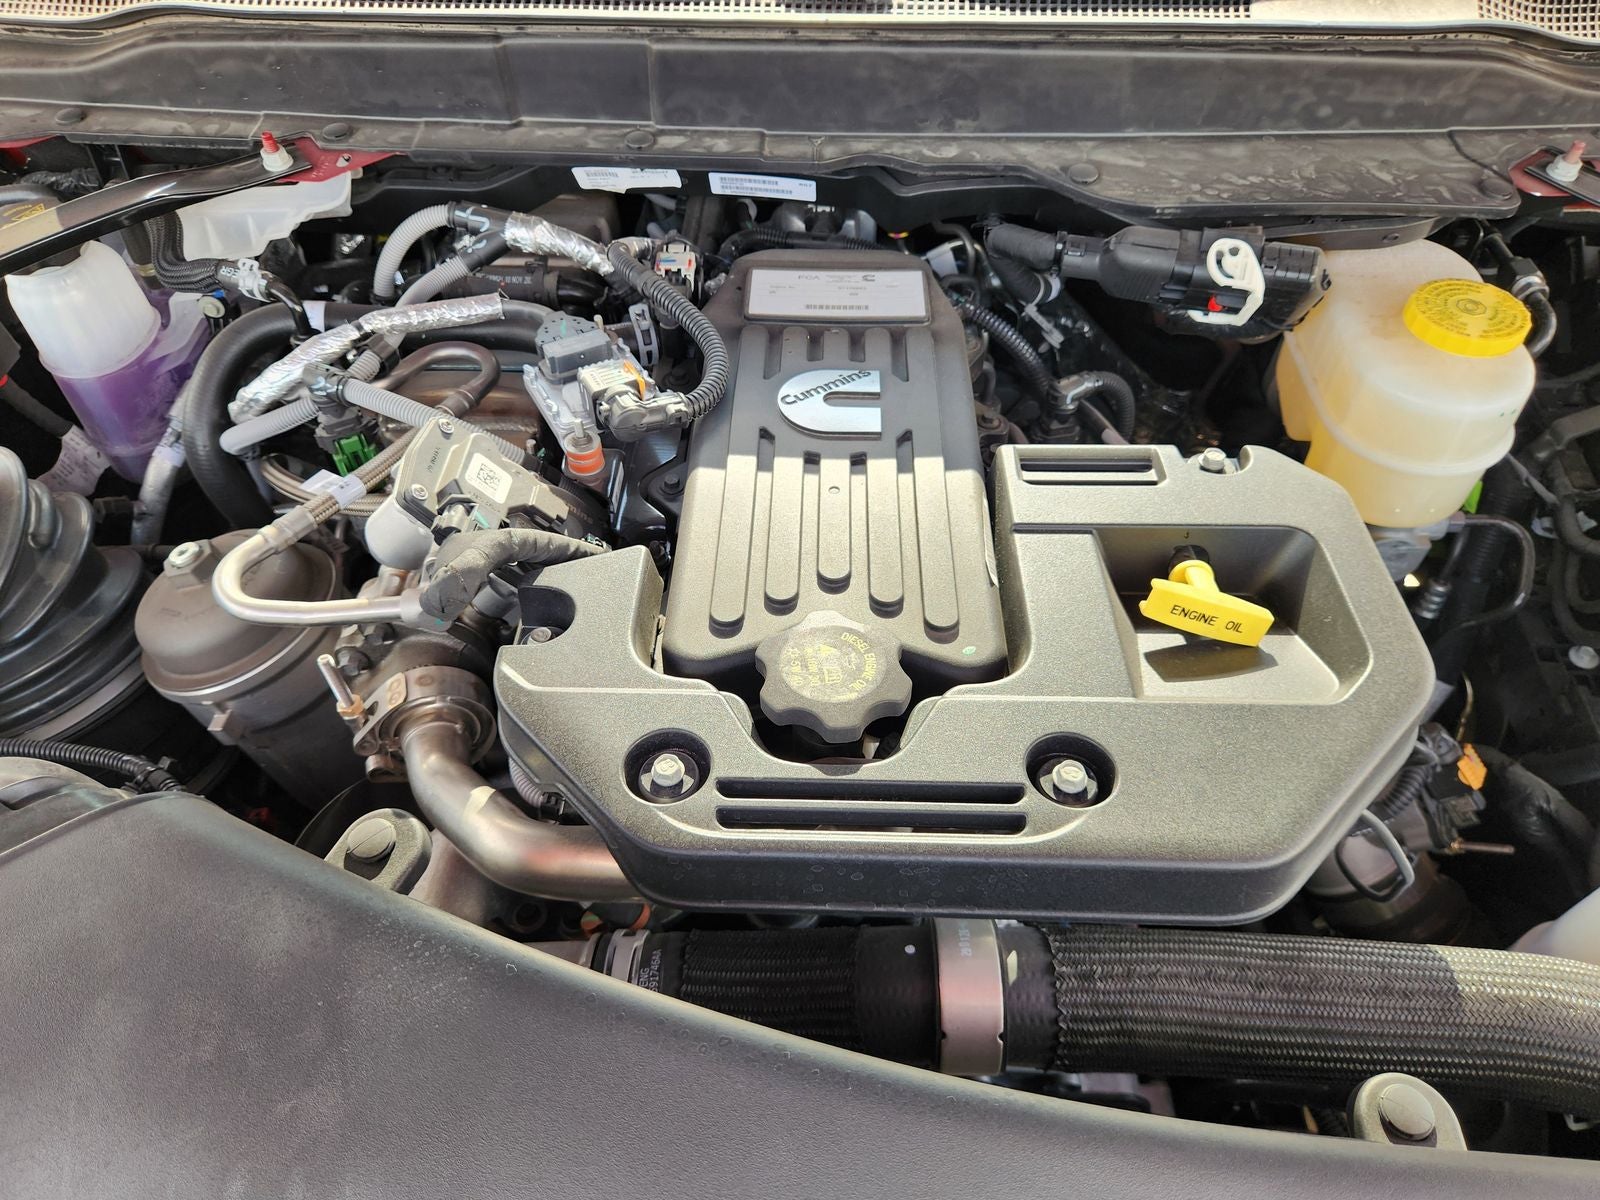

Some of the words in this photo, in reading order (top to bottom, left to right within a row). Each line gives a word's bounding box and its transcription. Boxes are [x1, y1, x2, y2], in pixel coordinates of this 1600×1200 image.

[220, 265, 240, 278] EGR
[780, 370, 871, 405] Cummins
[1170, 604, 1219, 626] ENGINE
[1225, 620, 1243, 634] OIL
[841, 632, 870, 653] DIESEL
[862, 653, 877, 681] ENGINE
[849, 679, 867, 690] OIL
[639, 967, 650, 987] ENG
